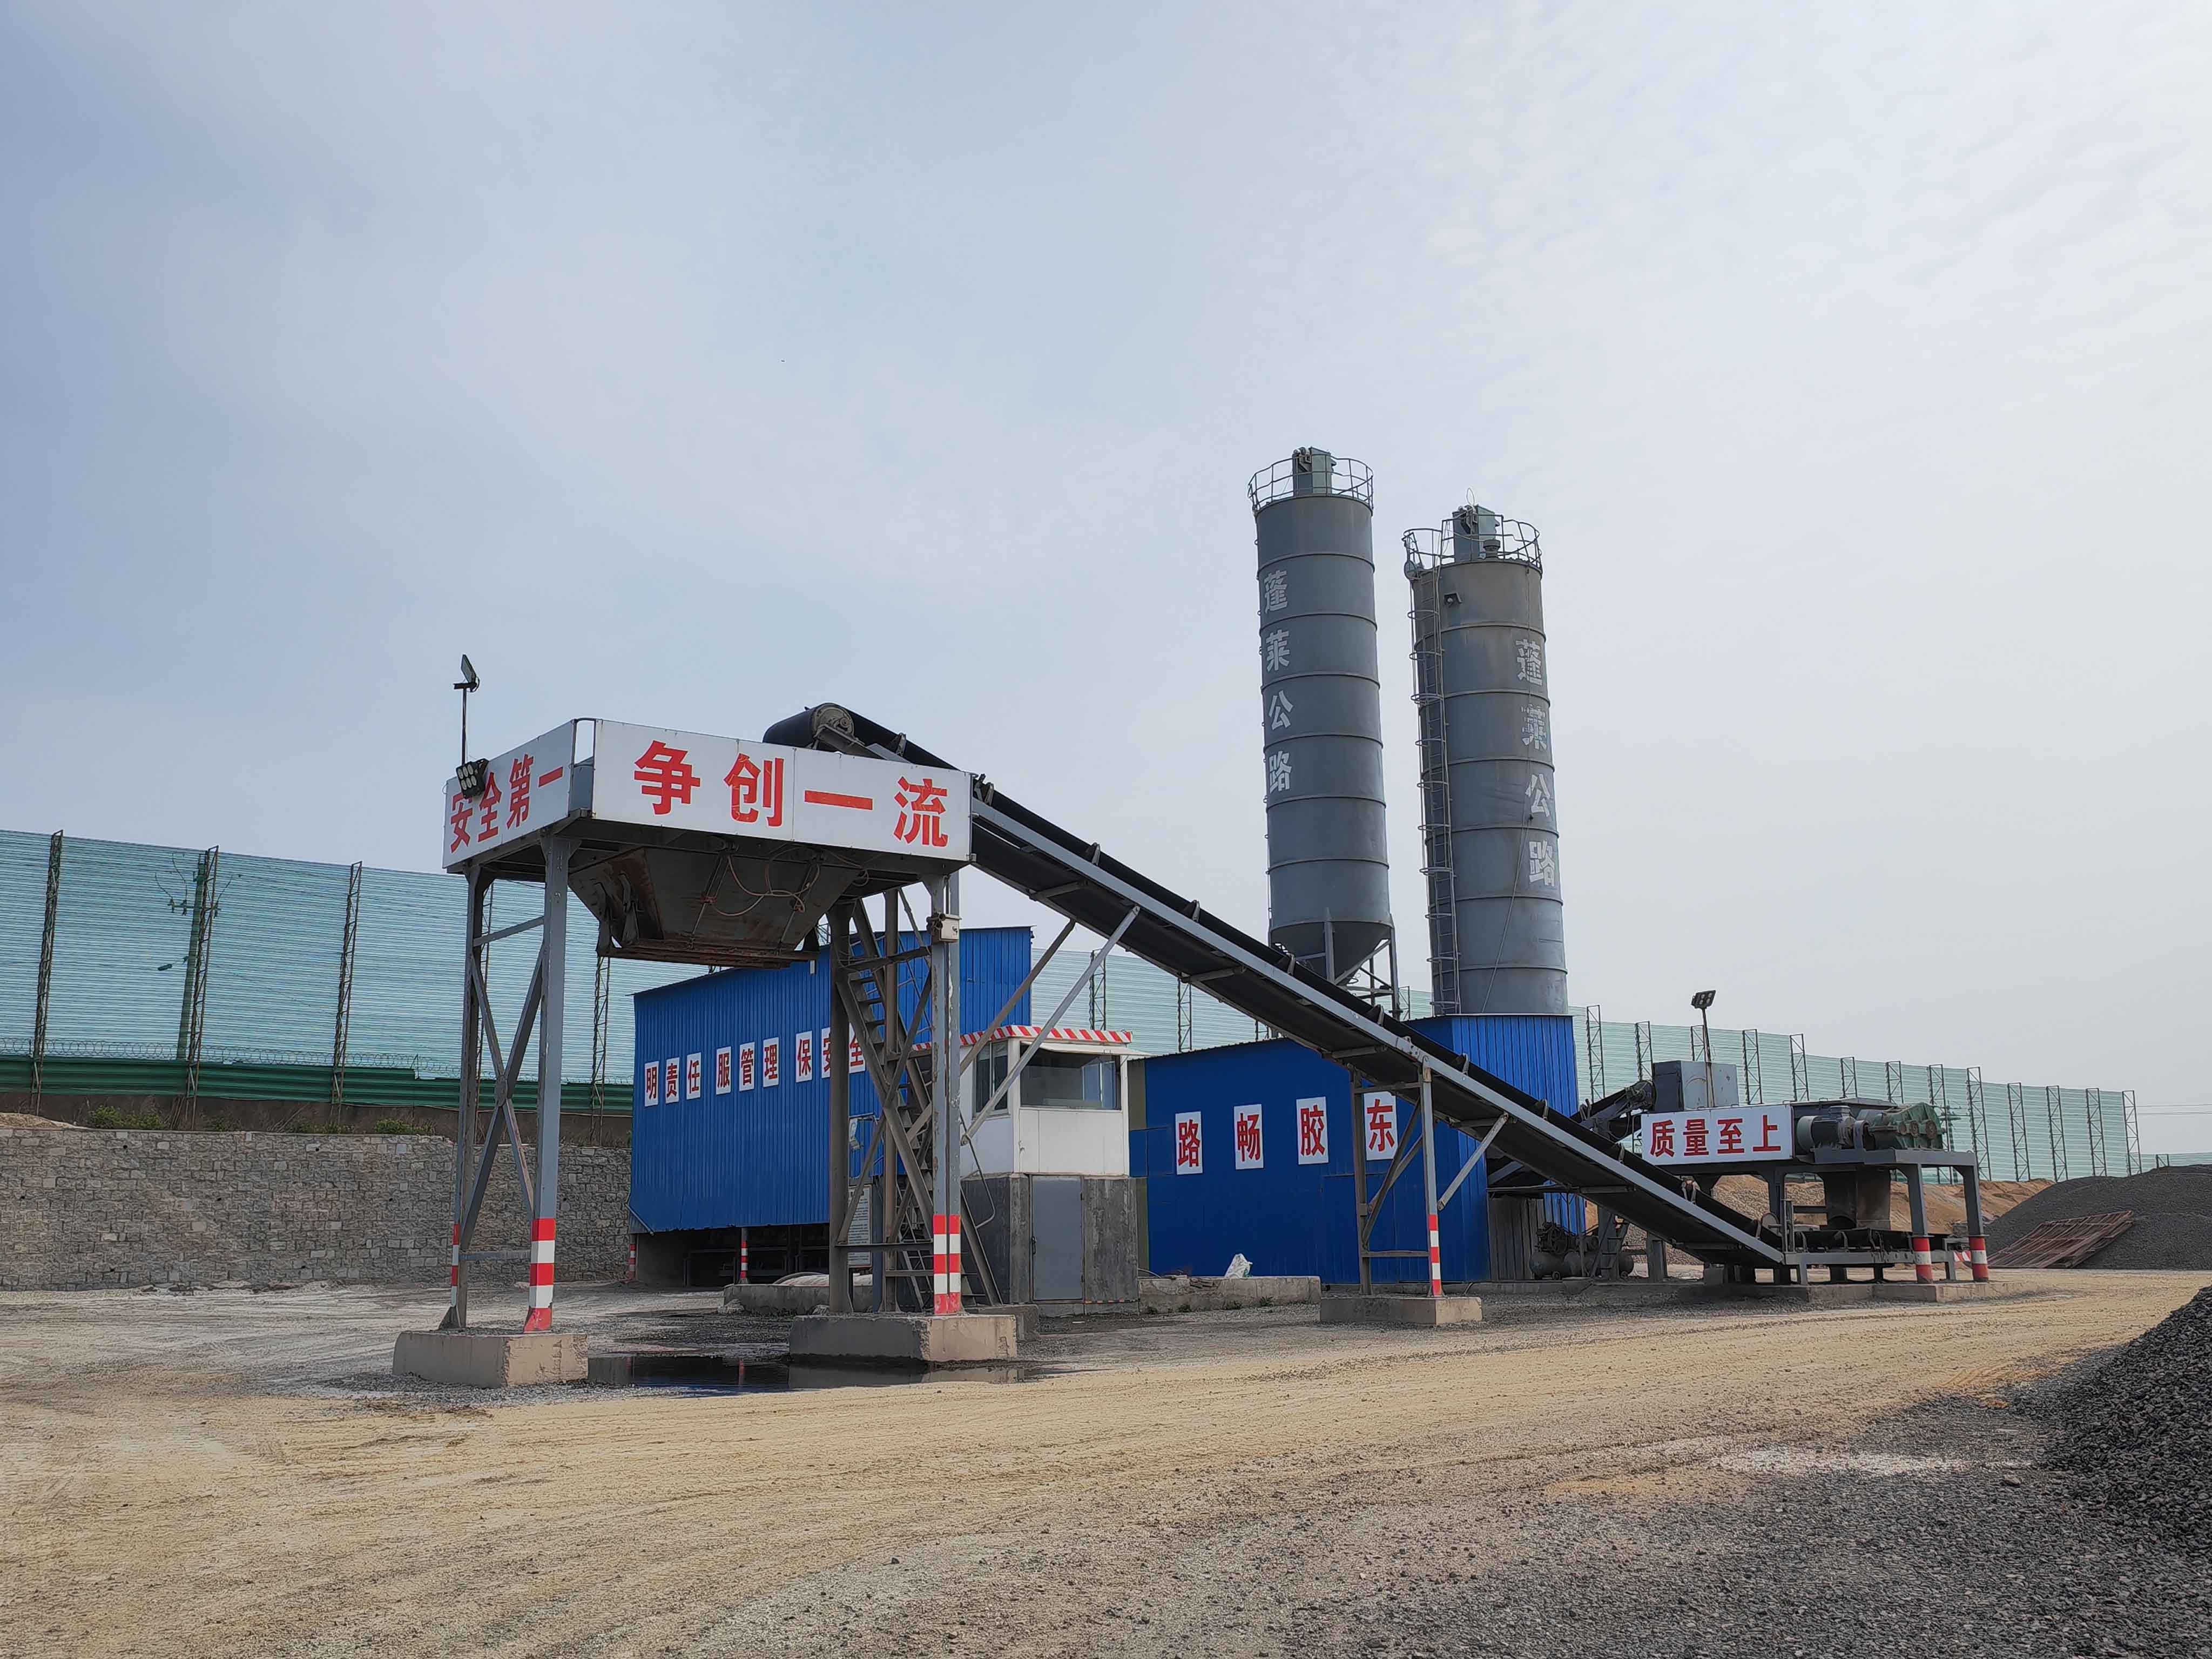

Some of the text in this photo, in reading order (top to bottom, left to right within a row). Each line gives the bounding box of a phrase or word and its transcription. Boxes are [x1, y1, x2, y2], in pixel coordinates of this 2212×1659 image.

[1264, 570, 1293, 792] 蓬莱公路
[450, 754, 563, 853] 安全第一
[633, 740, 948, 847] 争创一流
[1515, 639, 1555, 887] 蓬莱公路
[646, 1060, 700, 1100] 明责任
[717, 1044, 778, 1088] 服管理
[1178, 1100, 1394, 1166] 路畅胶东
[1650, 1115, 1781, 1157] 质量至上
